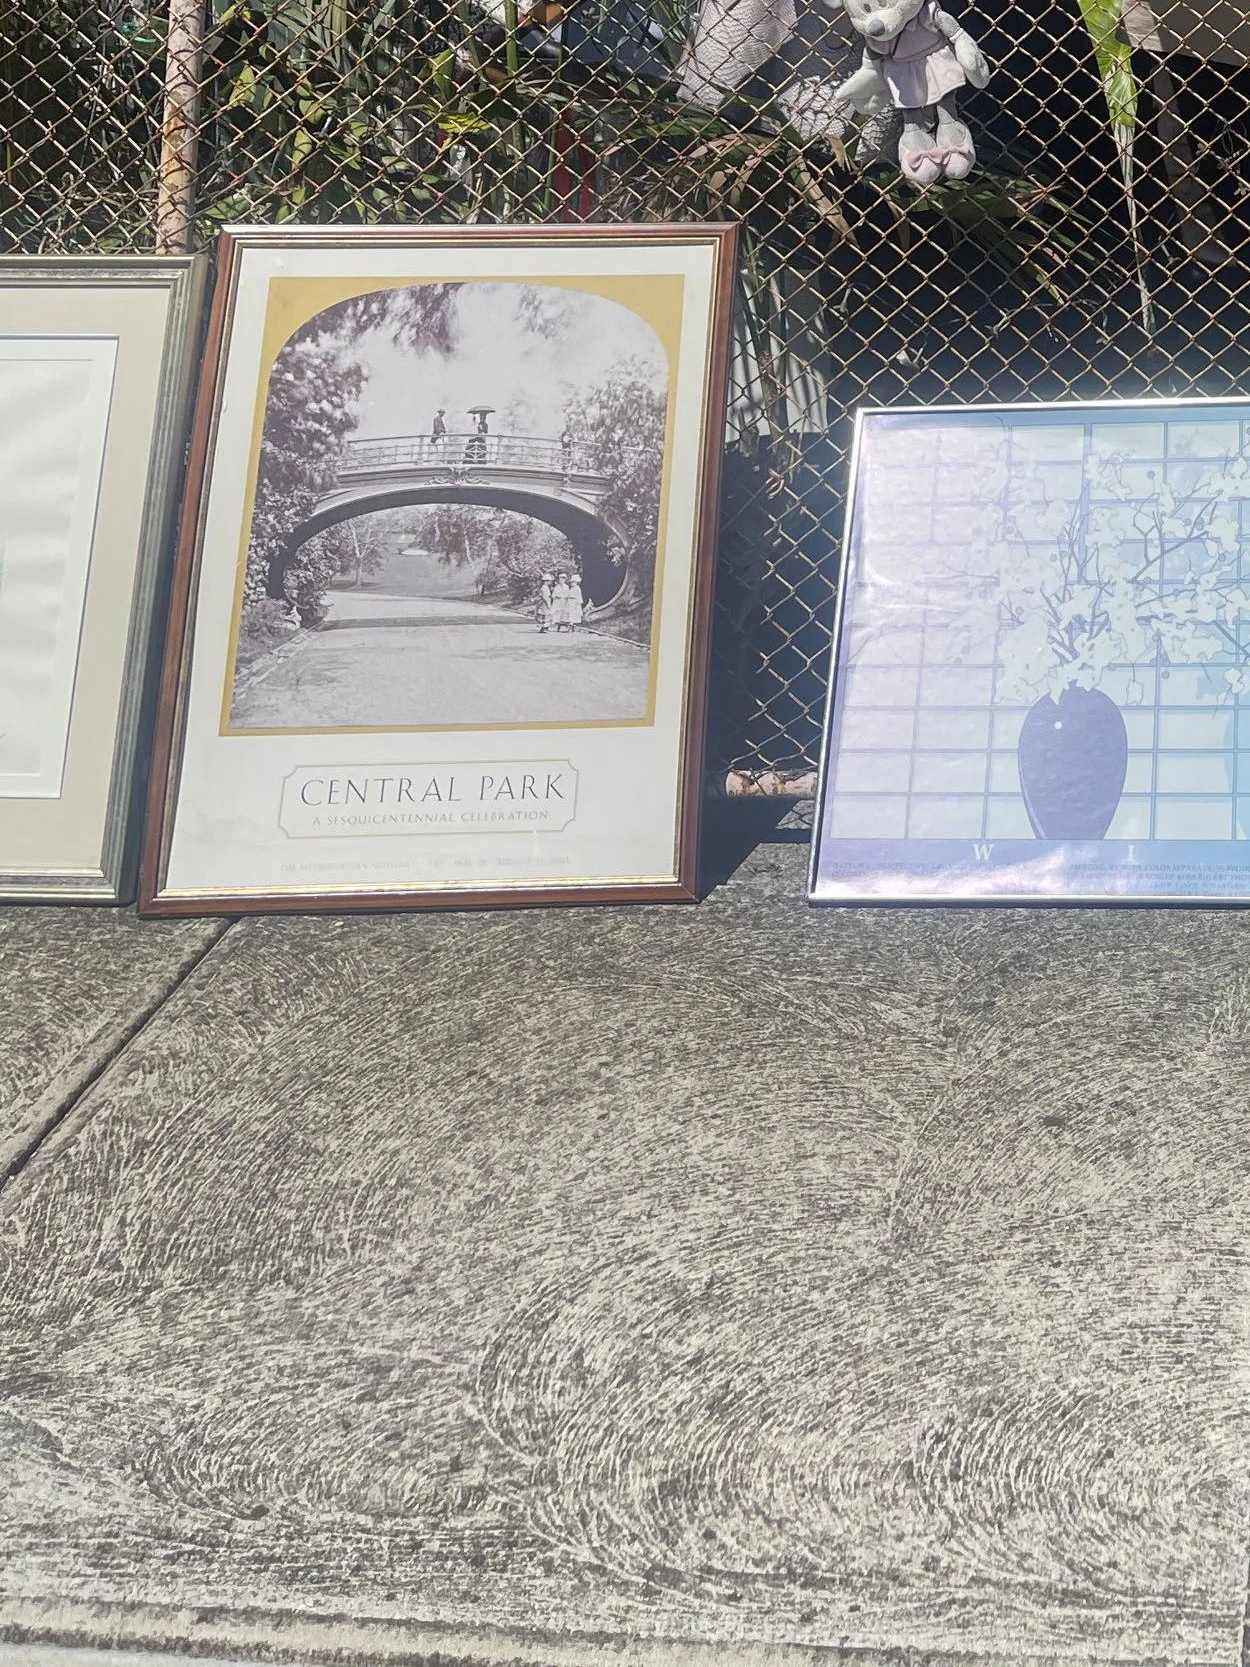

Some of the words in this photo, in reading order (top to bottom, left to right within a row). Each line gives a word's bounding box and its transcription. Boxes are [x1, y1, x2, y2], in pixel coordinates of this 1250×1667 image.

[300, 775, 462, 807] CENTRAL
[479, 773, 566, 802] PARK
[312, 817, 321, 826] A
[327, 812, 455, 826] SESQUICENTENNIAL
[460, 810, 549, 824] CELEBRATION
[972, 843, 995, 862] W
[1127, 844, 1136, 862] I
